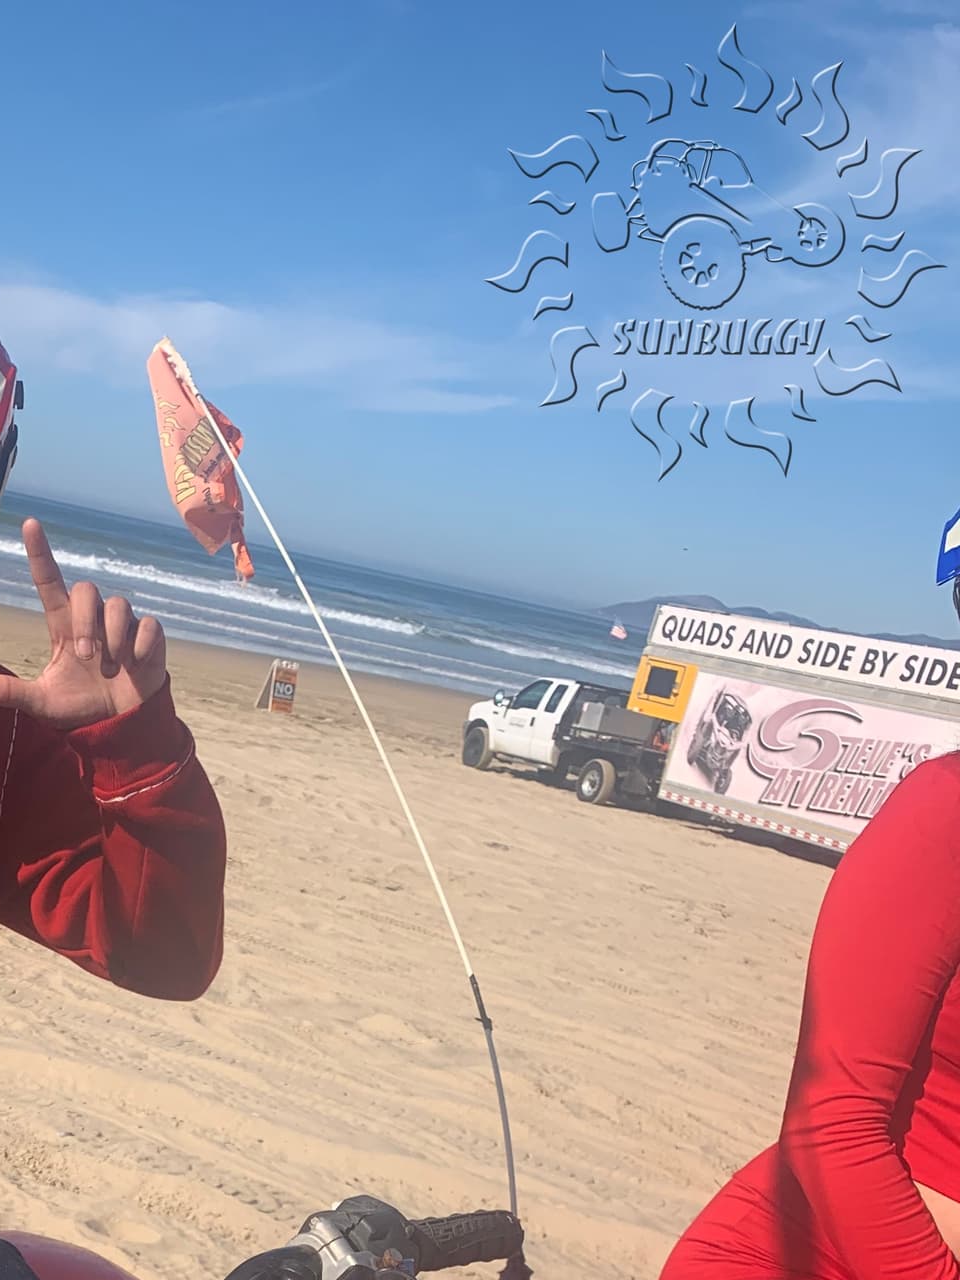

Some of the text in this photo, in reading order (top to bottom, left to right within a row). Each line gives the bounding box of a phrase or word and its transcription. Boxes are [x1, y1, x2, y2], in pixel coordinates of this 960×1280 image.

[661, 614, 960, 690] QUADS AND SIDE BY SIDE
[274, 681, 294, 697] NO
[758, 767, 822, 809] ATV
